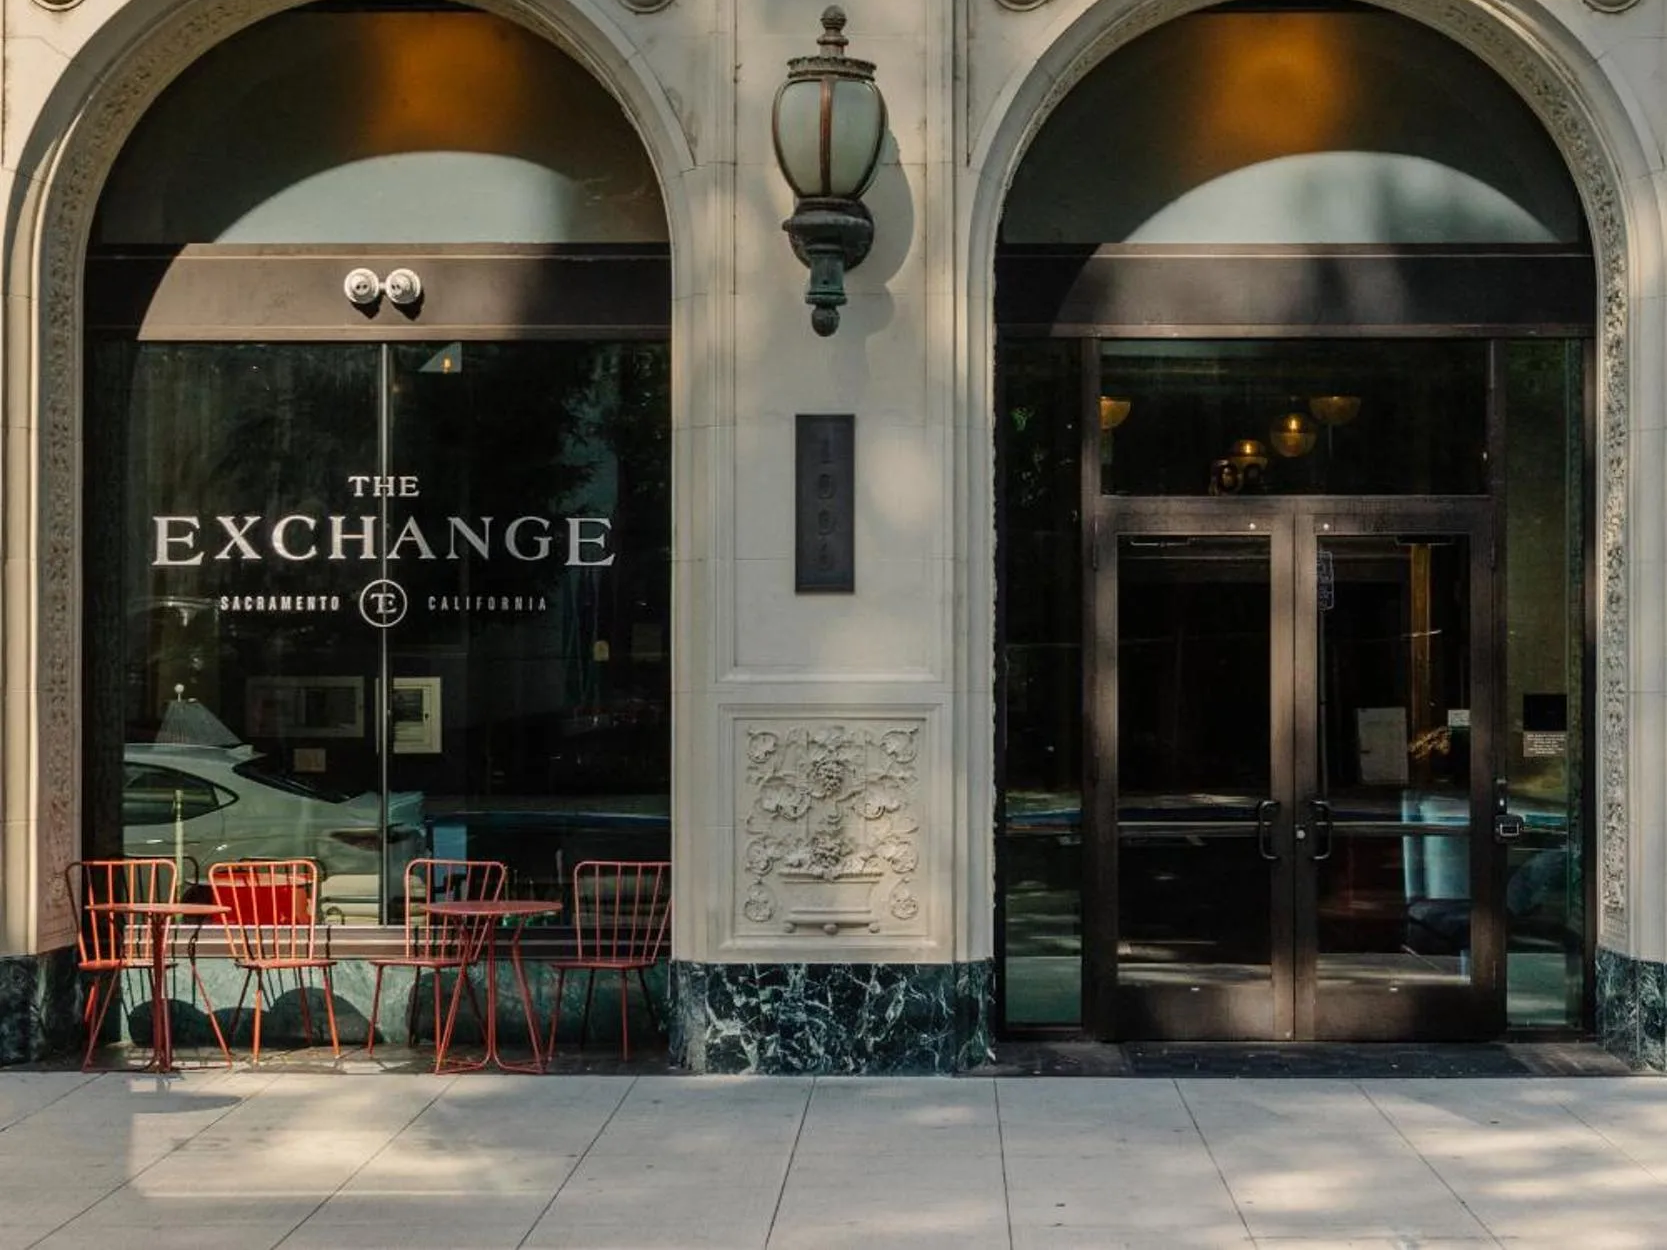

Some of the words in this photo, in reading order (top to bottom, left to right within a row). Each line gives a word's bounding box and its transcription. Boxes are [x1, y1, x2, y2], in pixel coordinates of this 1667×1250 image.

[347, 475, 420, 497] THE
[151, 514, 616, 567] EXCHANGE
[220, 595, 341, 612] SACRAMENTO
[427, 595, 547, 612] CALIFORNIA
